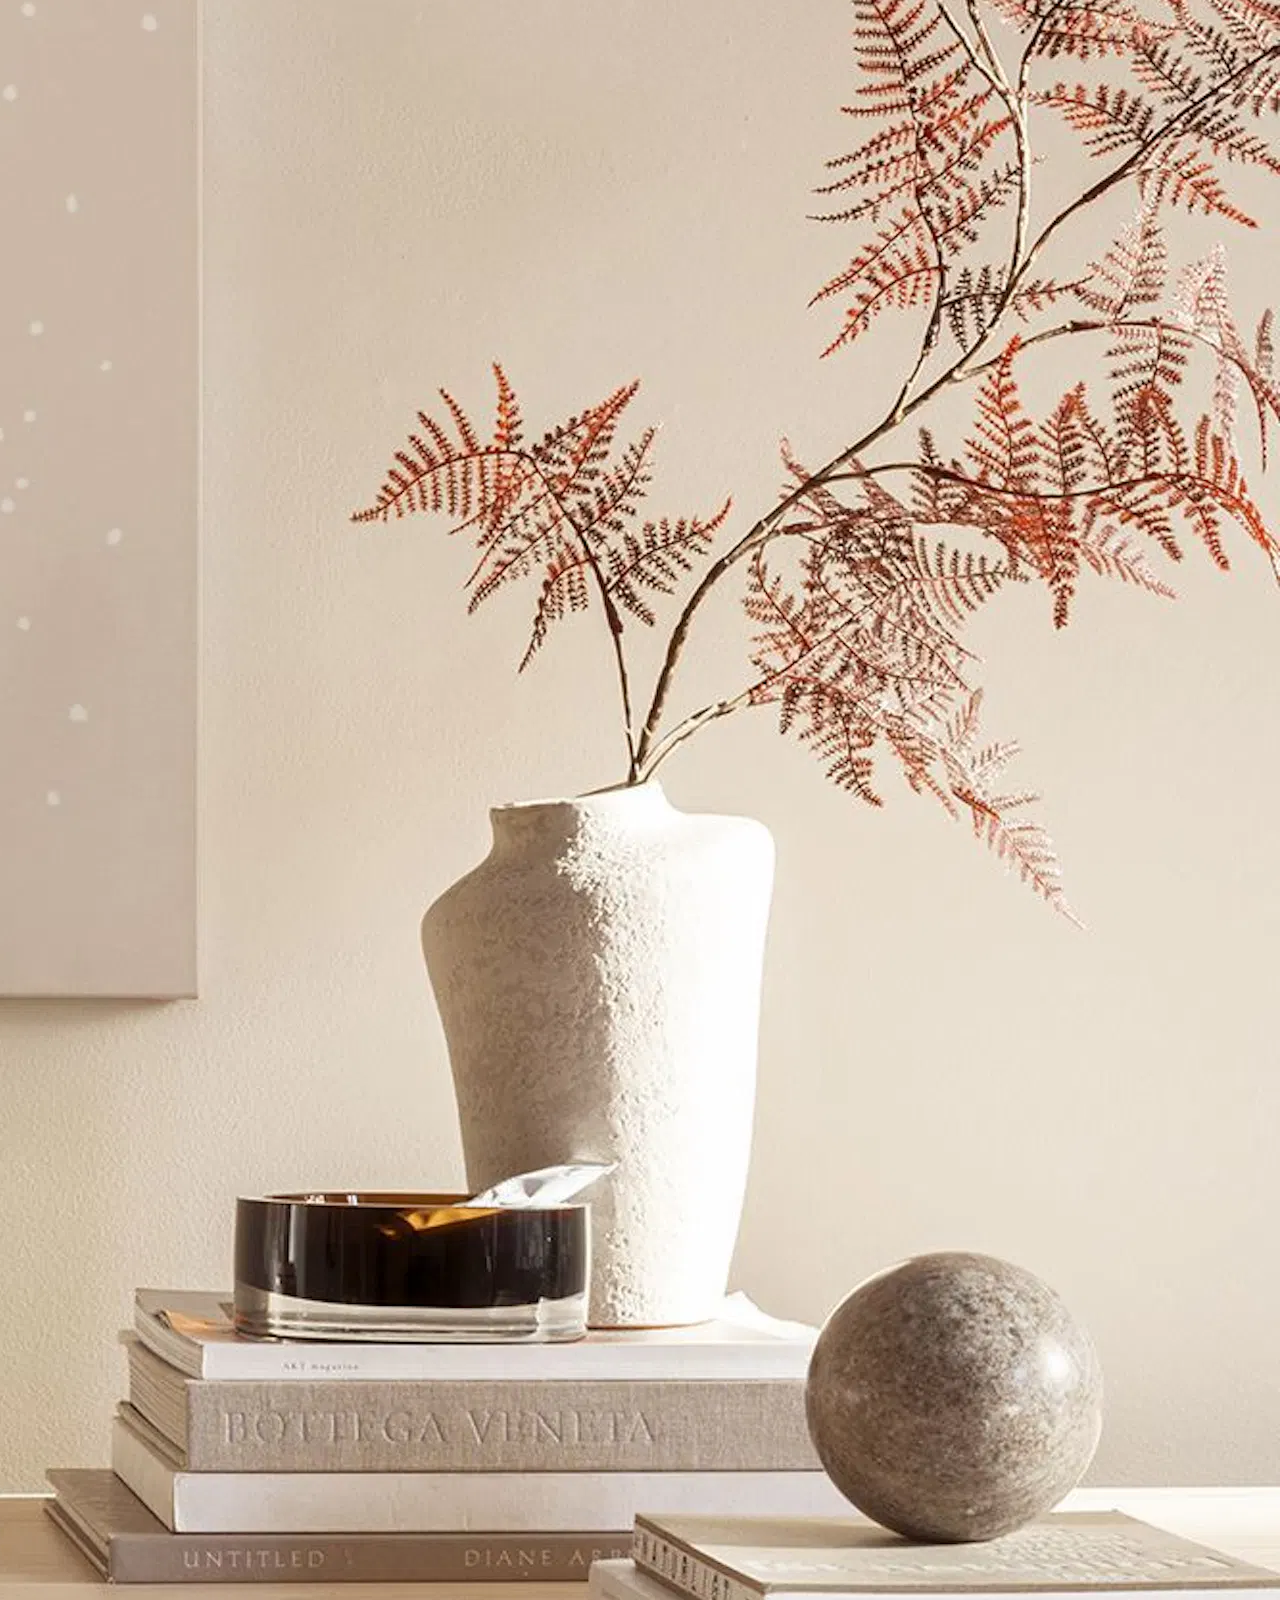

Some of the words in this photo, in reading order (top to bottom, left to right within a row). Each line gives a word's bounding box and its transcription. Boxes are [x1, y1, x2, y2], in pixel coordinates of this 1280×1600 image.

[222, 1410, 449, 1445] BOTTEGA
[464, 1410, 658, 1445] VENETA
[182, 1550, 326, 1569] UNTITLED
[464, 1549, 553, 1568] DIANE
